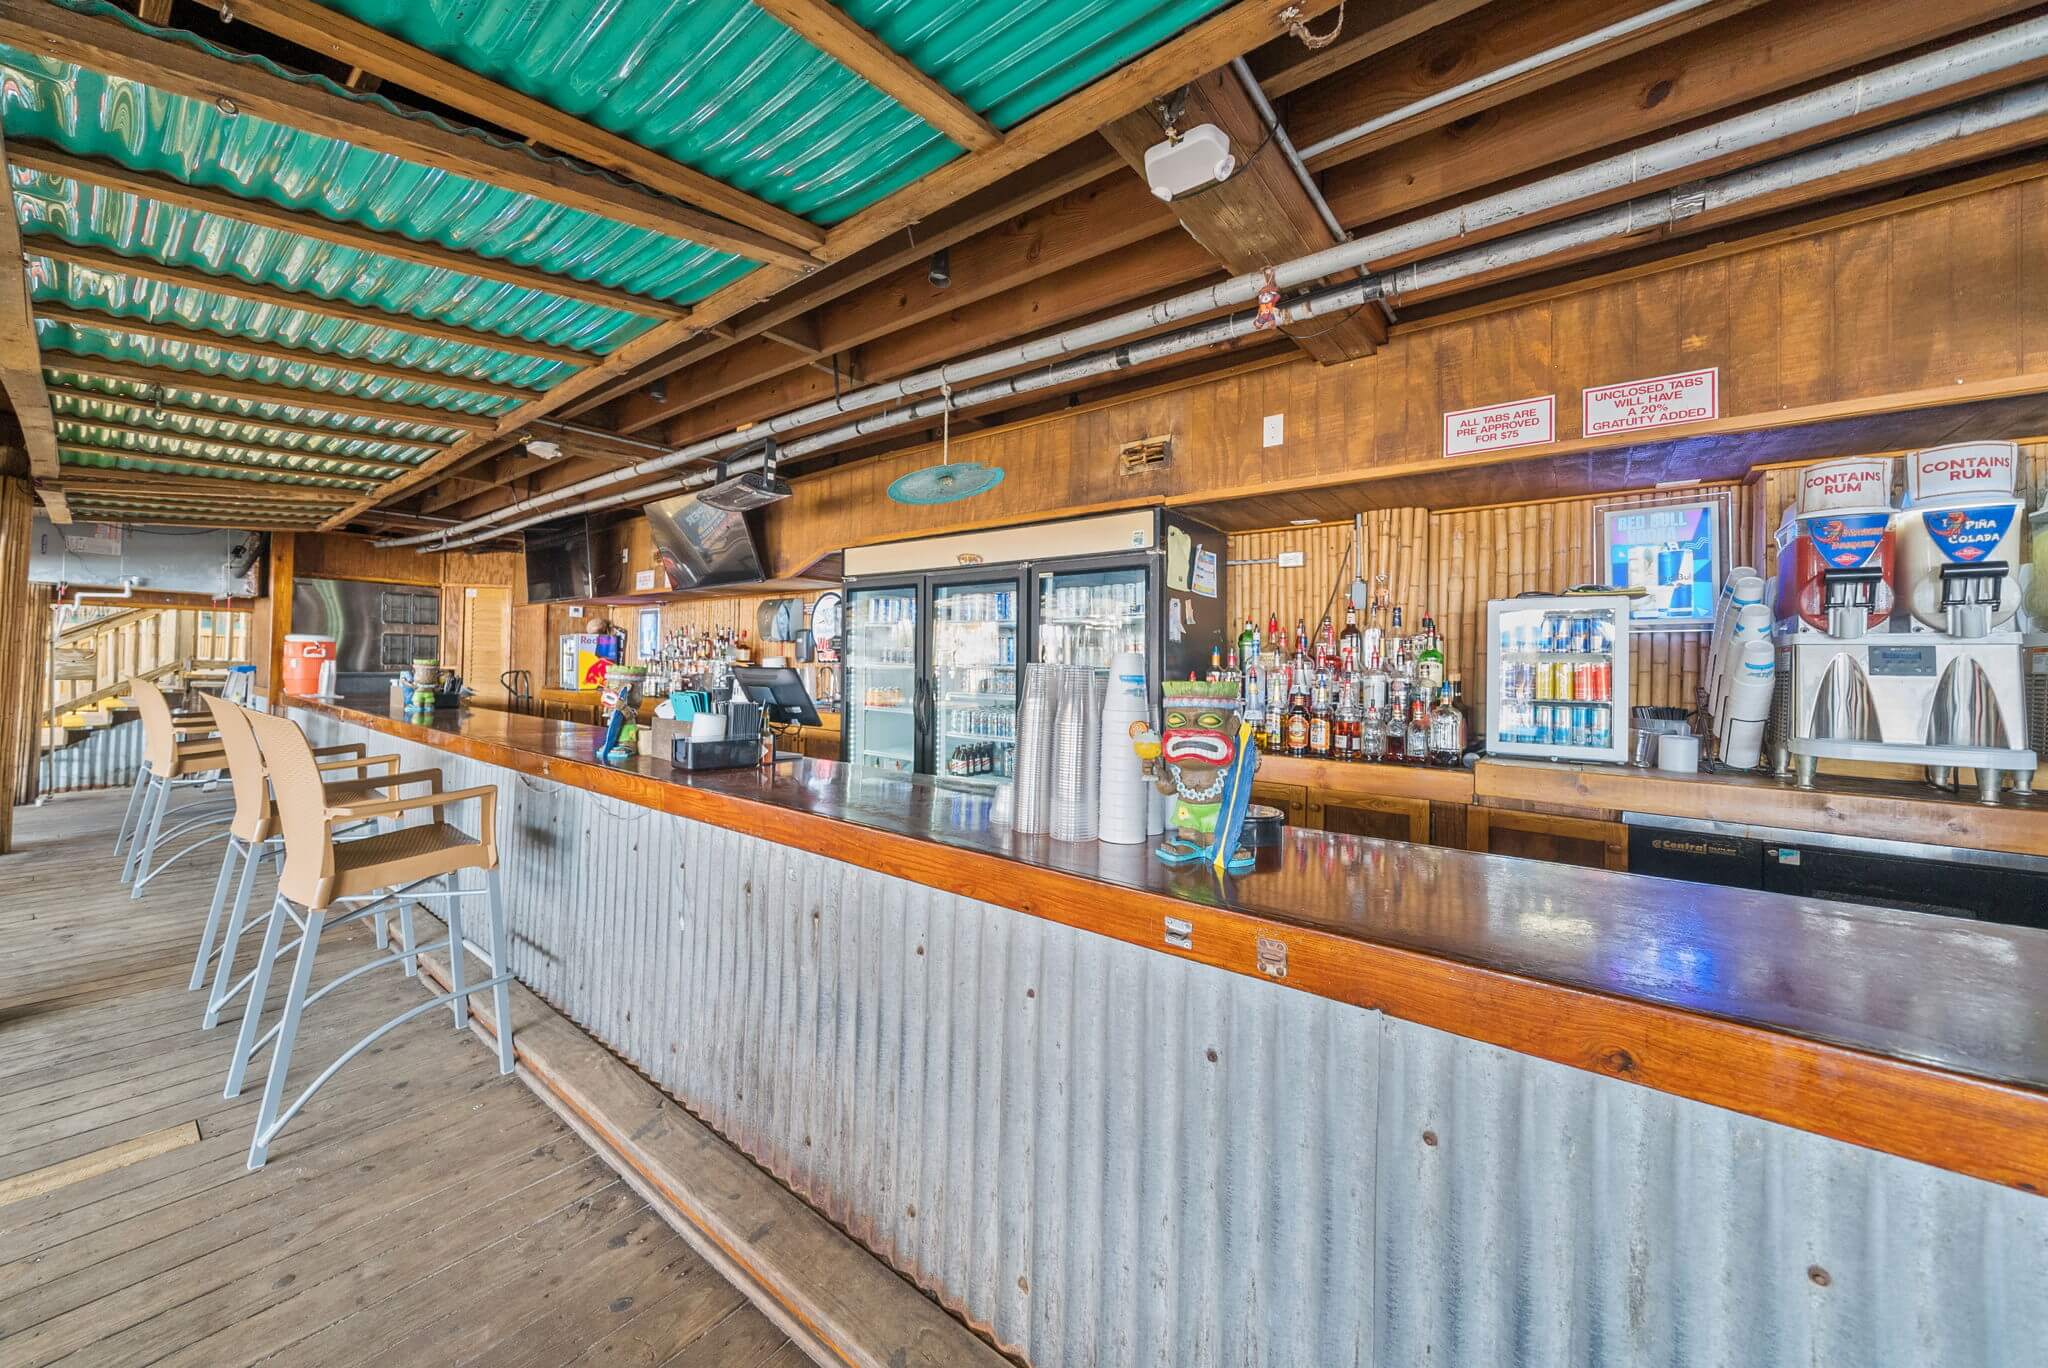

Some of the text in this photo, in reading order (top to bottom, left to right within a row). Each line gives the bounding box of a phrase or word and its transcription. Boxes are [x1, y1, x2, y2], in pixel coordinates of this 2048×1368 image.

[1595, 377, 1704, 401] UNCLOSED TABS
[1614, 390, 1683, 408] WILL HAVE
[1460, 408, 1537, 428] ALL TABS ARE
[1627, 403, 1668, 417] A 20%
[1456, 418, 1540, 437] PRE APPROVED
[1592, 408, 1706, 431] GRATUITY ADDED
[1475, 430, 1520, 443] FOR $75
[1922, 457, 2010, 473] CONTAINS
[1806, 472, 1881, 488] CONTAINS
[1949, 469, 1992, 481] RUM
[1824, 483, 1862, 495] RUM
[1965, 519, 1997, 530] PIÑA
[1948, 533, 2000, 544] COLADA
